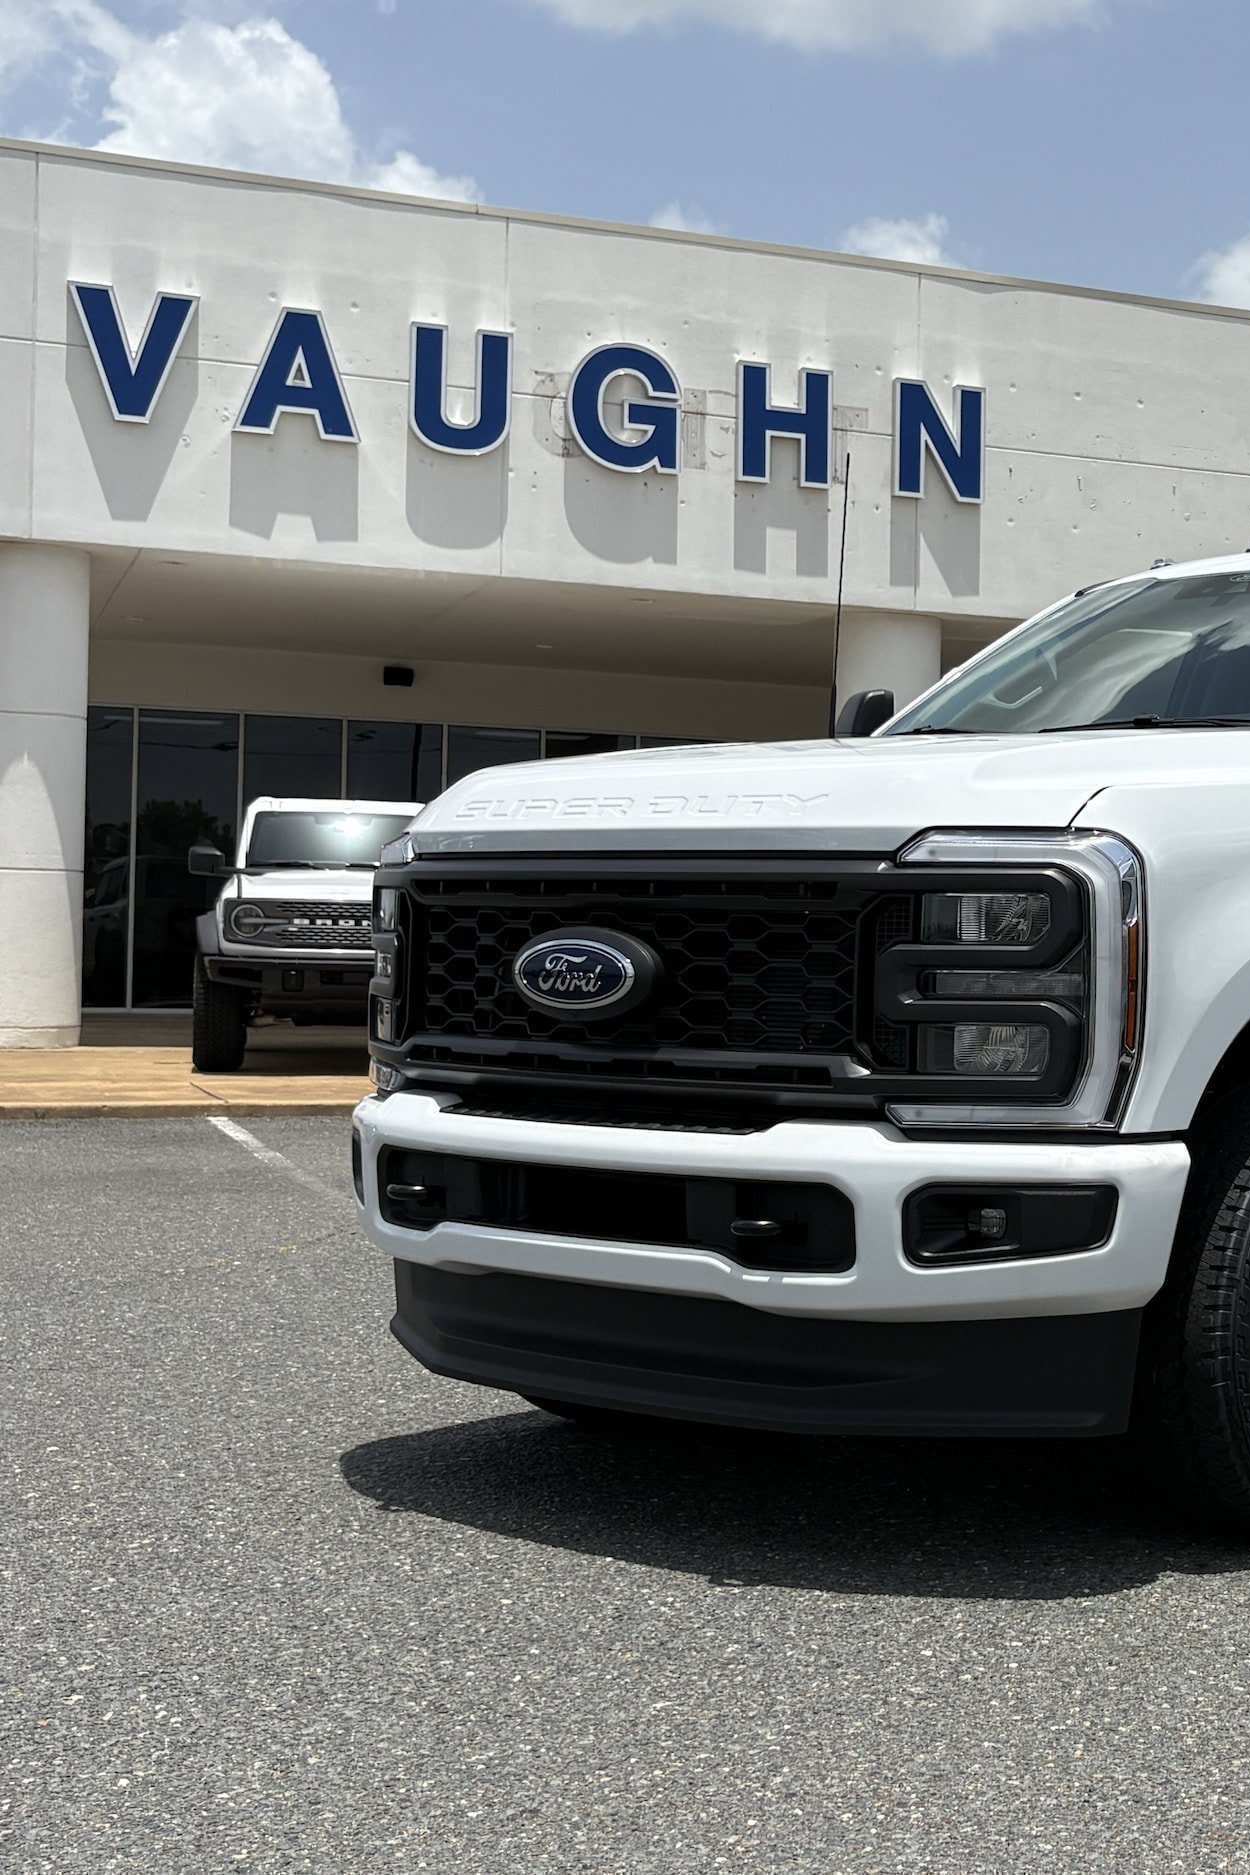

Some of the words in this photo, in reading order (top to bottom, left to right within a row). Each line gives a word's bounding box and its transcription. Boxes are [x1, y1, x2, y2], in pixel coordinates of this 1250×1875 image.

[67, 280, 986, 504] VAUGHN
[453, 796, 635, 822] SUPER
[645, 793, 829, 818] DUTY
[538, 952, 602, 993] Ford
